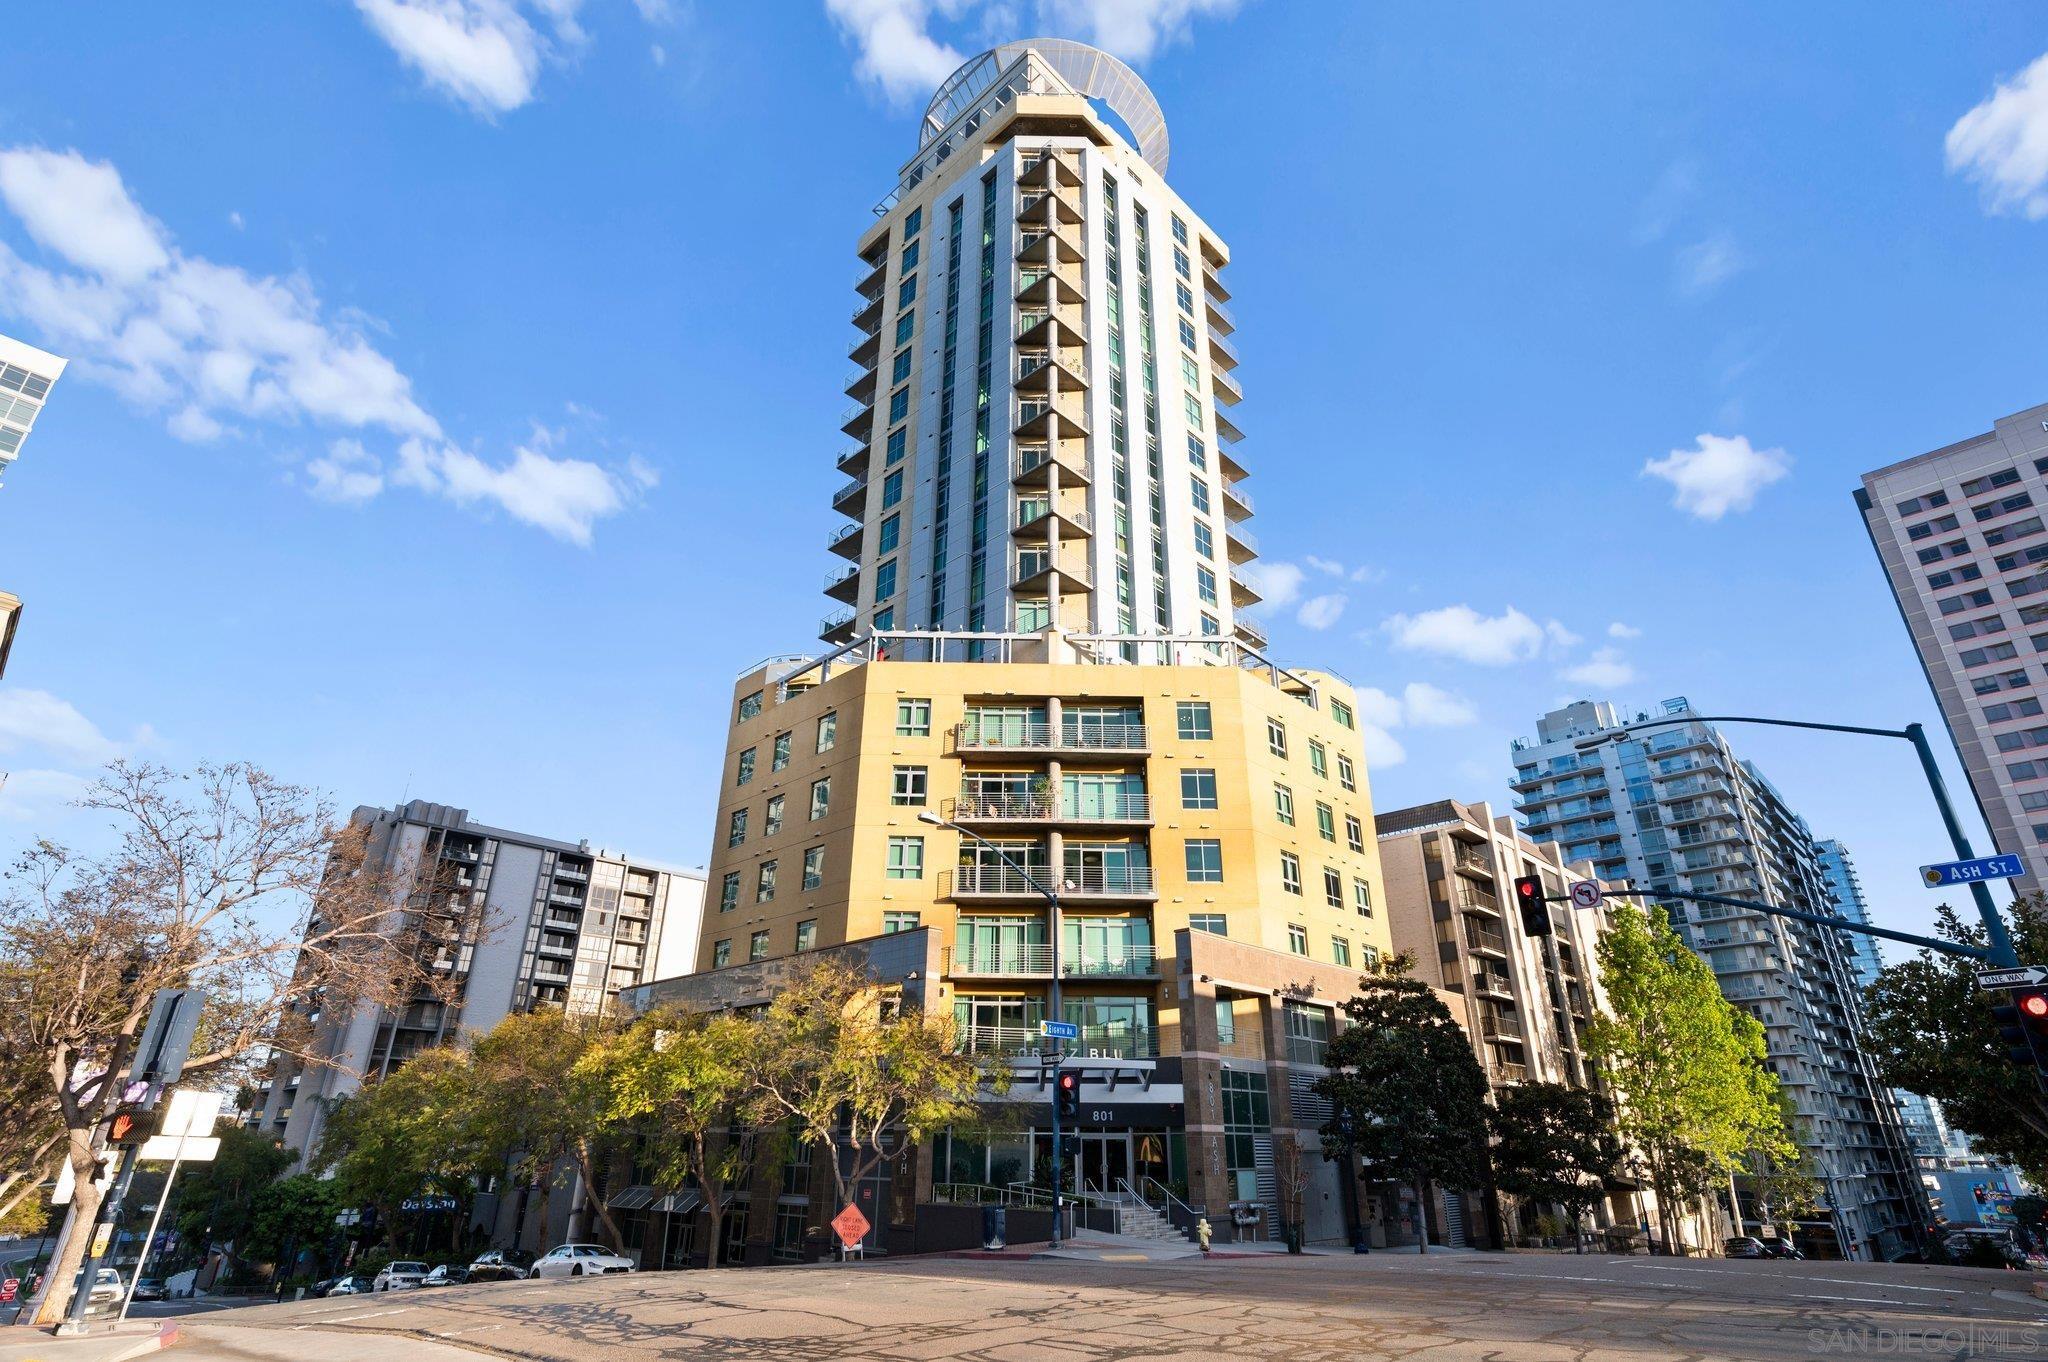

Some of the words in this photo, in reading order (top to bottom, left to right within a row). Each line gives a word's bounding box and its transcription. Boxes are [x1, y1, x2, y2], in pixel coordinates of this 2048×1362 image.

[1951, 866, 1981, 880] ASH
[1988, 861, 2013, 875] ST.
[1984, 976, 2003, 984] ONE
[2007, 973, 2025, 982] WAY
[1089, 1048, 1123, 1060] BLU
[1092, 1110, 1114, 1121] 801
